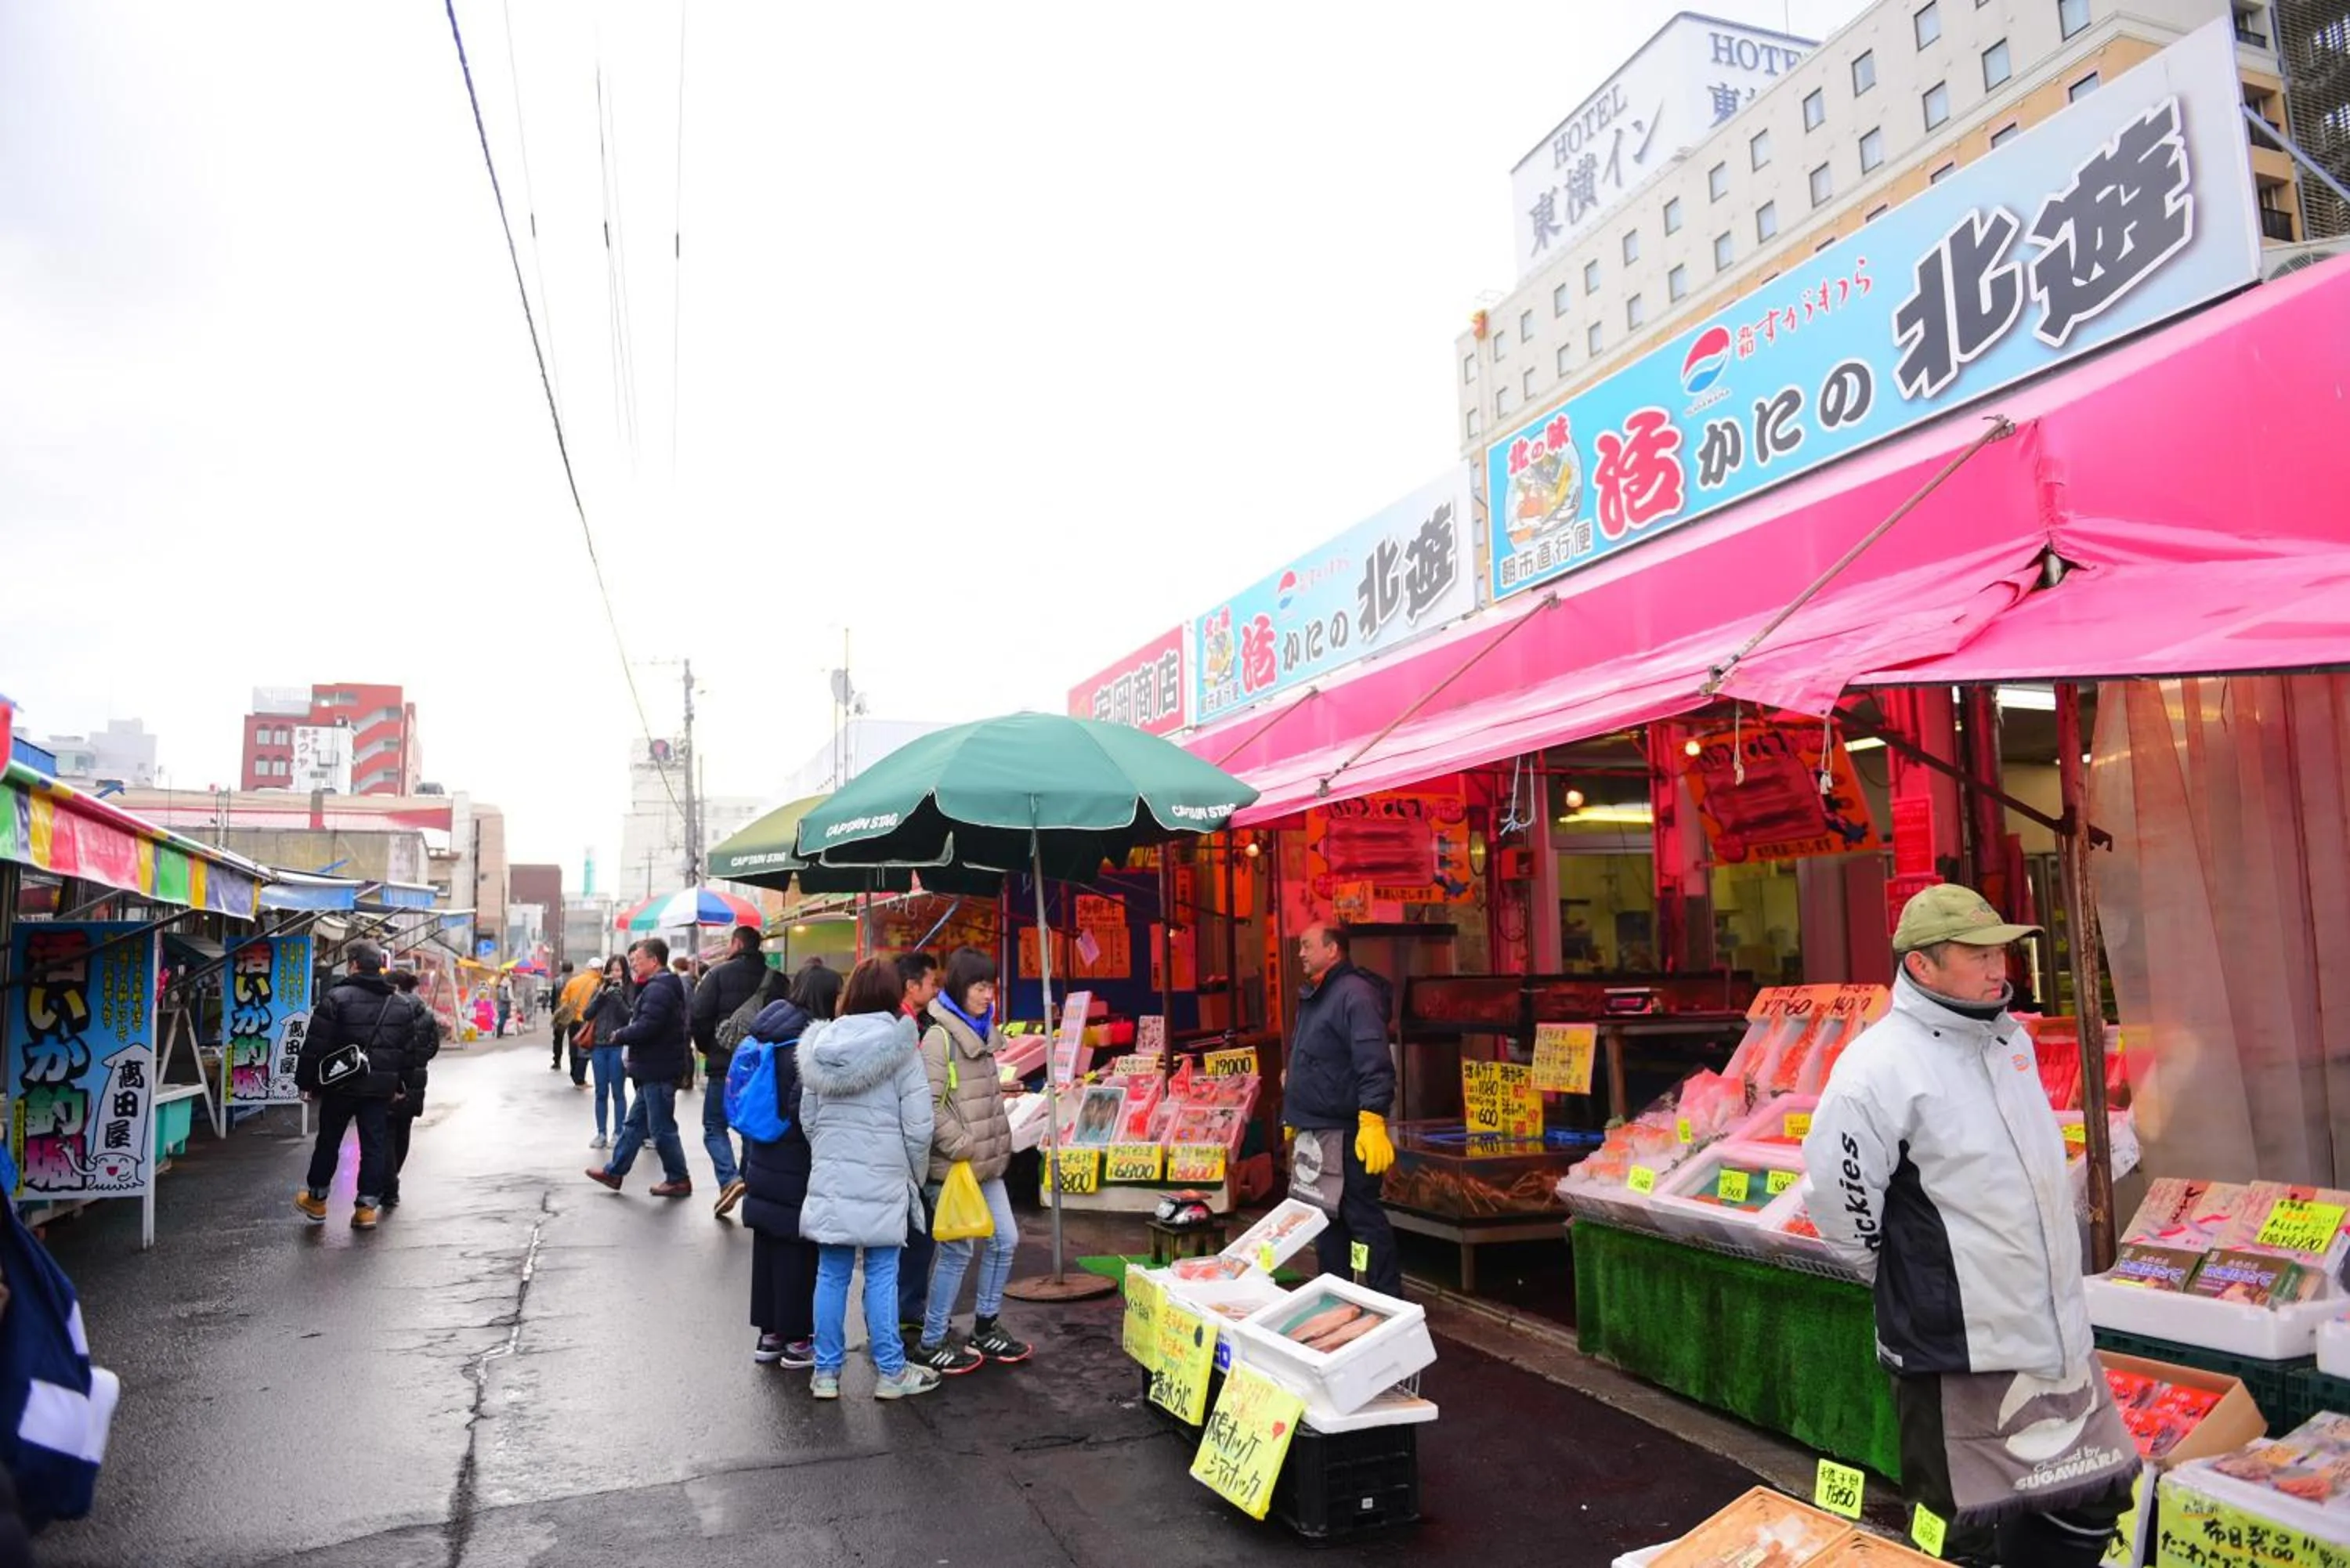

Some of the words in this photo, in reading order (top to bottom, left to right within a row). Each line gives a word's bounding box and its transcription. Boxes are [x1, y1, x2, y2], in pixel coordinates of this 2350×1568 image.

[1709, 32, 1808, 76] HOTE
[1553, 84, 1629, 170] HOTEL
[1529, 97, 1666, 258] 東横イン
[1509, 414, 1571, 476] 北の味
[1595, 407, 1684, 539] 活
[1502, 521, 1593, 587] 朝市直行便
[826, 818, 870, 837] CAPTAIN
[870, 813, 899, 829] STAG
[731, 854, 766, 867] CAPTAIN
[2014, 1448, 2124, 1490] SUGAWARA
